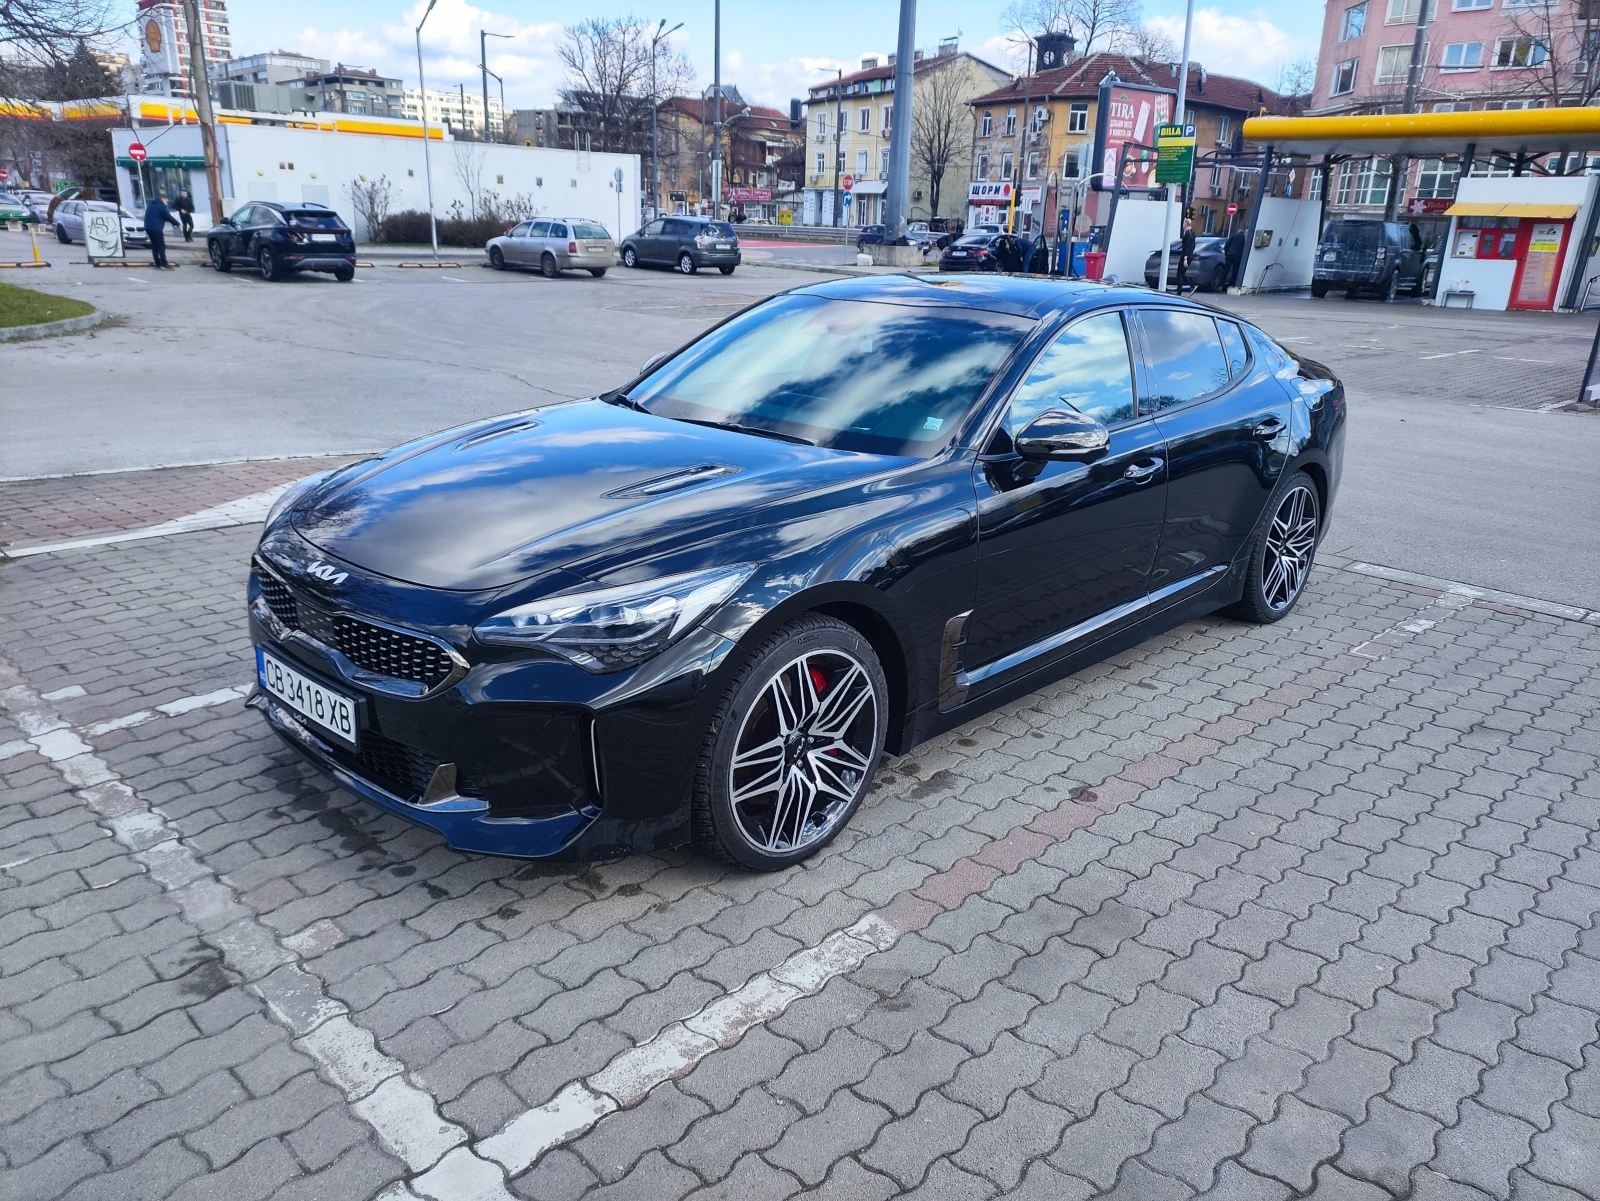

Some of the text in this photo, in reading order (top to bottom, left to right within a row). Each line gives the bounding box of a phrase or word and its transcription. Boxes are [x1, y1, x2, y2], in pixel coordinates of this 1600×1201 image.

[1110, 102, 1135, 119] TIRA
[1160, 125, 1195, 136] BILLA P
[971, 185, 1001, 196] ЩОРИ
[306, 560, 350, 585] KIA
[266, 659, 352, 735] CB 3418 XB
